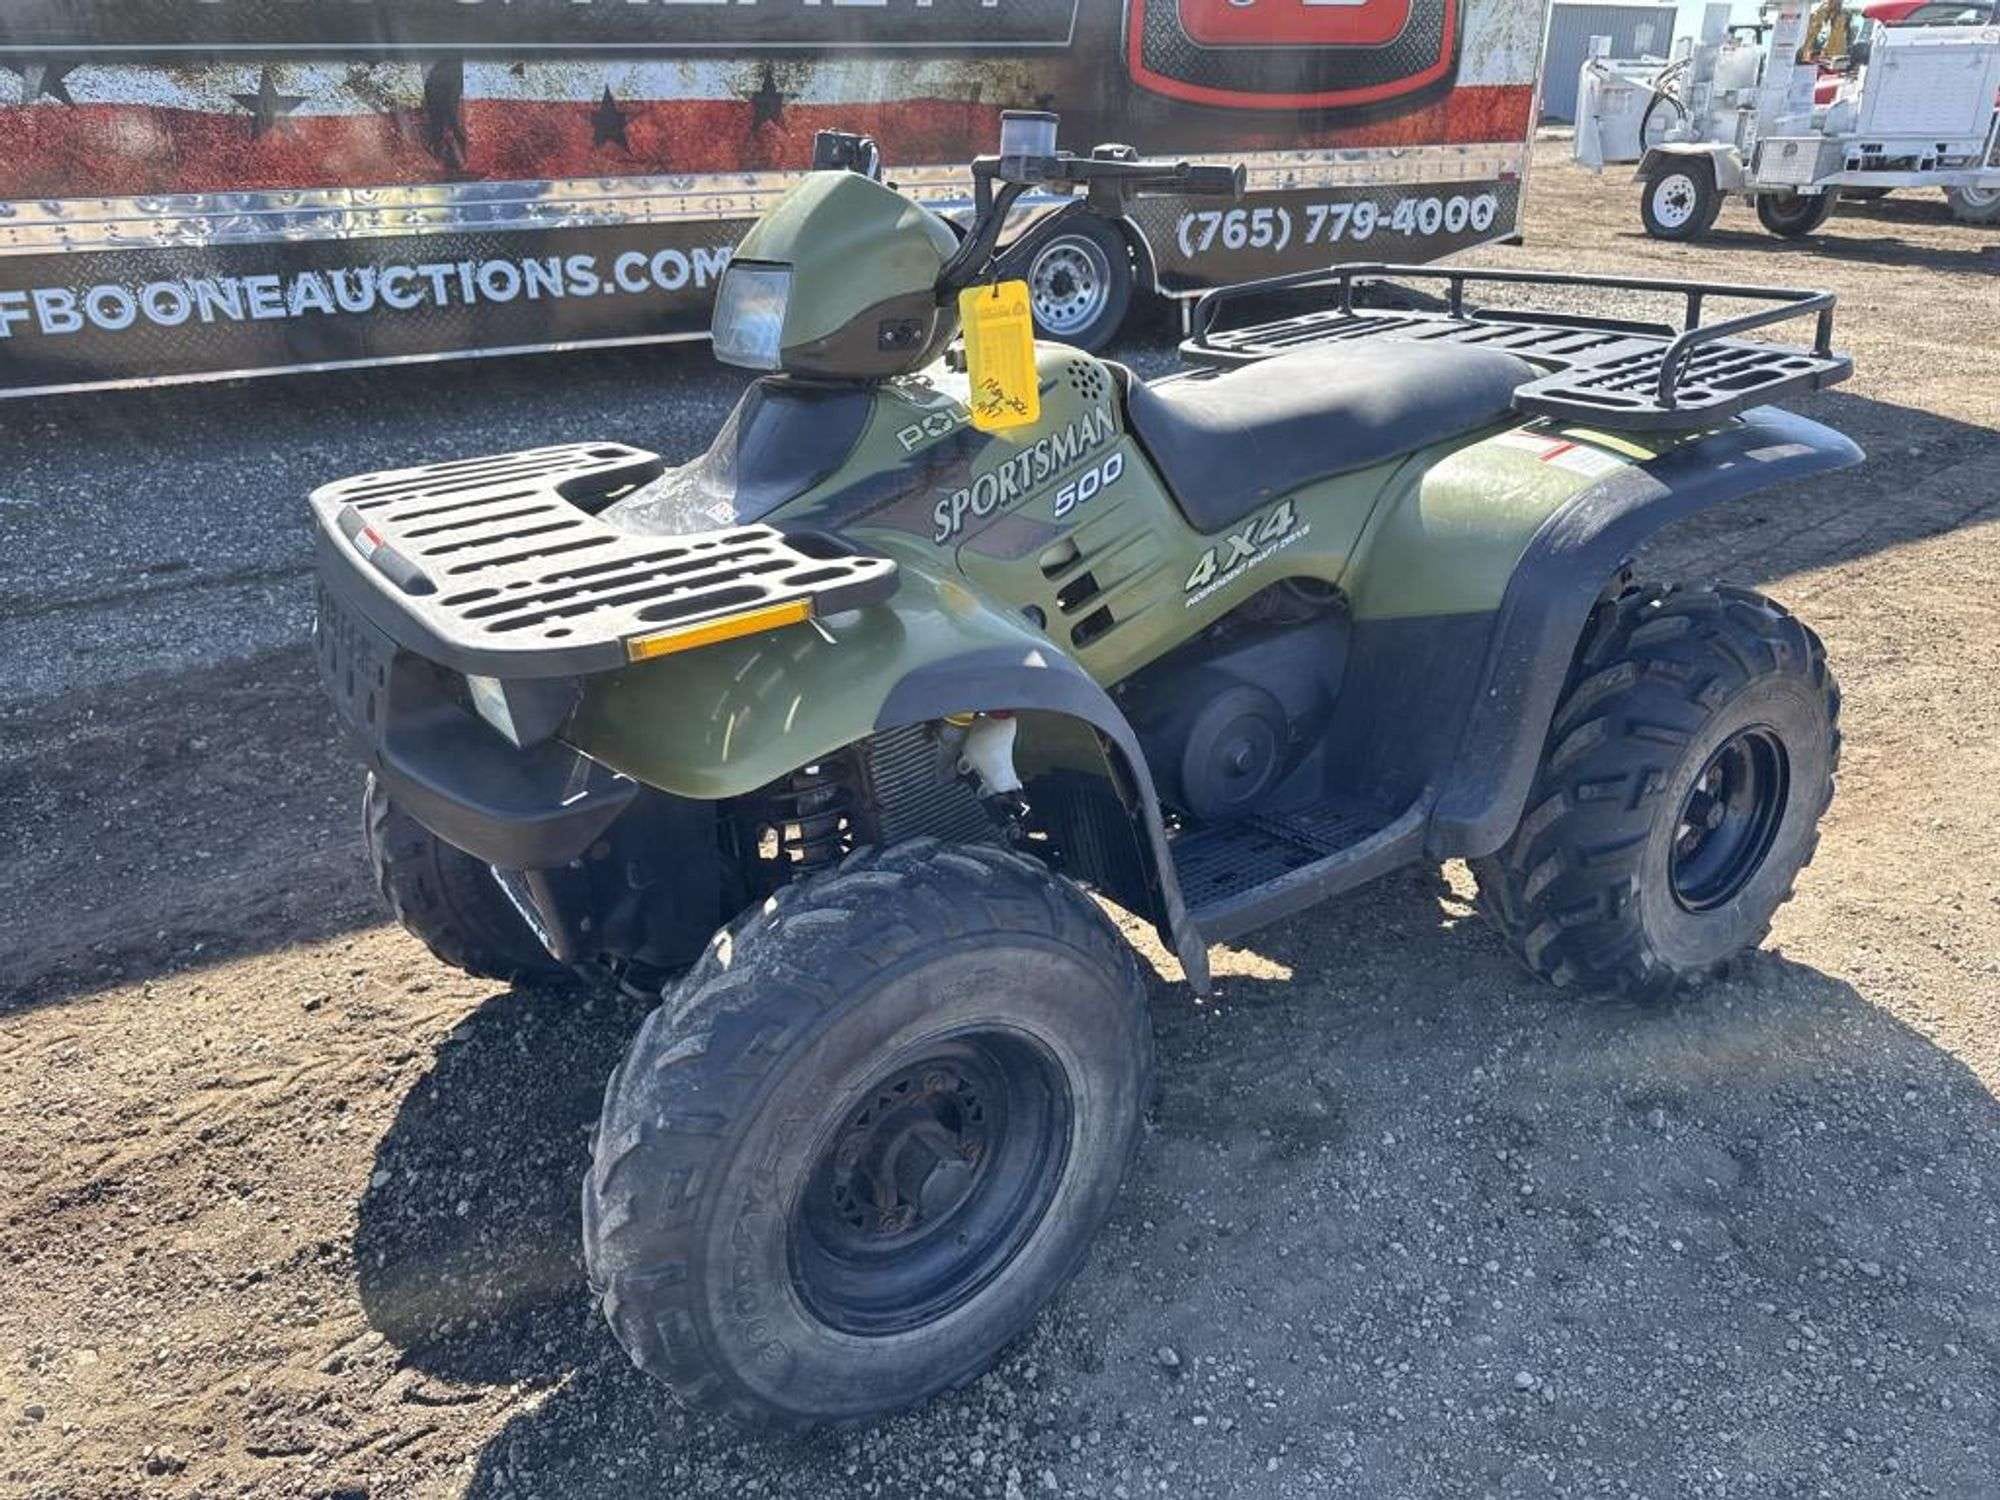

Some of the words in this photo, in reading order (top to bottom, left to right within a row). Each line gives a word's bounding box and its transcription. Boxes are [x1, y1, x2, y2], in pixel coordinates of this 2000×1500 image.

[1178, 205, 1291, 259] (765)
[1305, 194, 1498, 244] 779-4000
[934, 400, 1115, 543] SPORTSMAN
[1055, 452, 1123, 518] 500
[1185, 499, 1297, 594] 4X4
